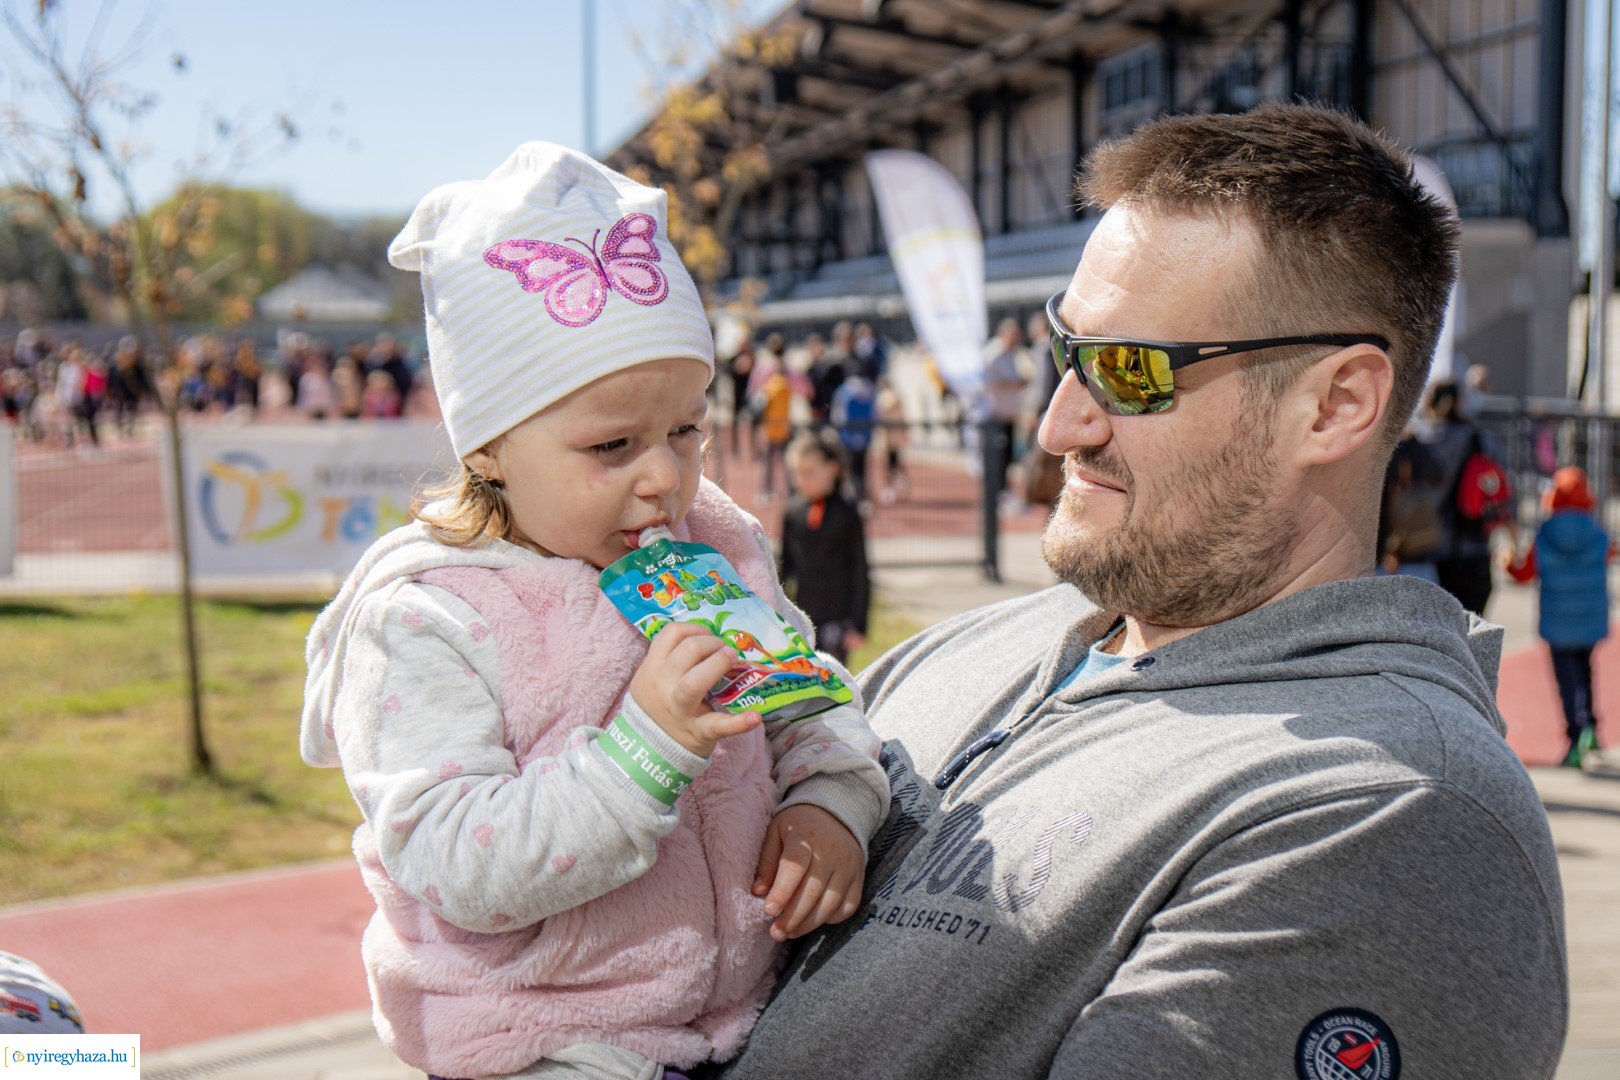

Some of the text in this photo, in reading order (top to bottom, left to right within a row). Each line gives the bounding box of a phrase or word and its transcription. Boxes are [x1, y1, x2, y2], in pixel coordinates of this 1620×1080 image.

[735, 671, 763, 691] ALMA
[736, 694, 765, 709] 120g
[631, 746, 674, 788] Futás
[1323, 1015, 1378, 1036] OCEAN RACE
[1304, 1031, 1320, 1059] TOOLS
[1379, 1040, 1391, 1079] AROUND
